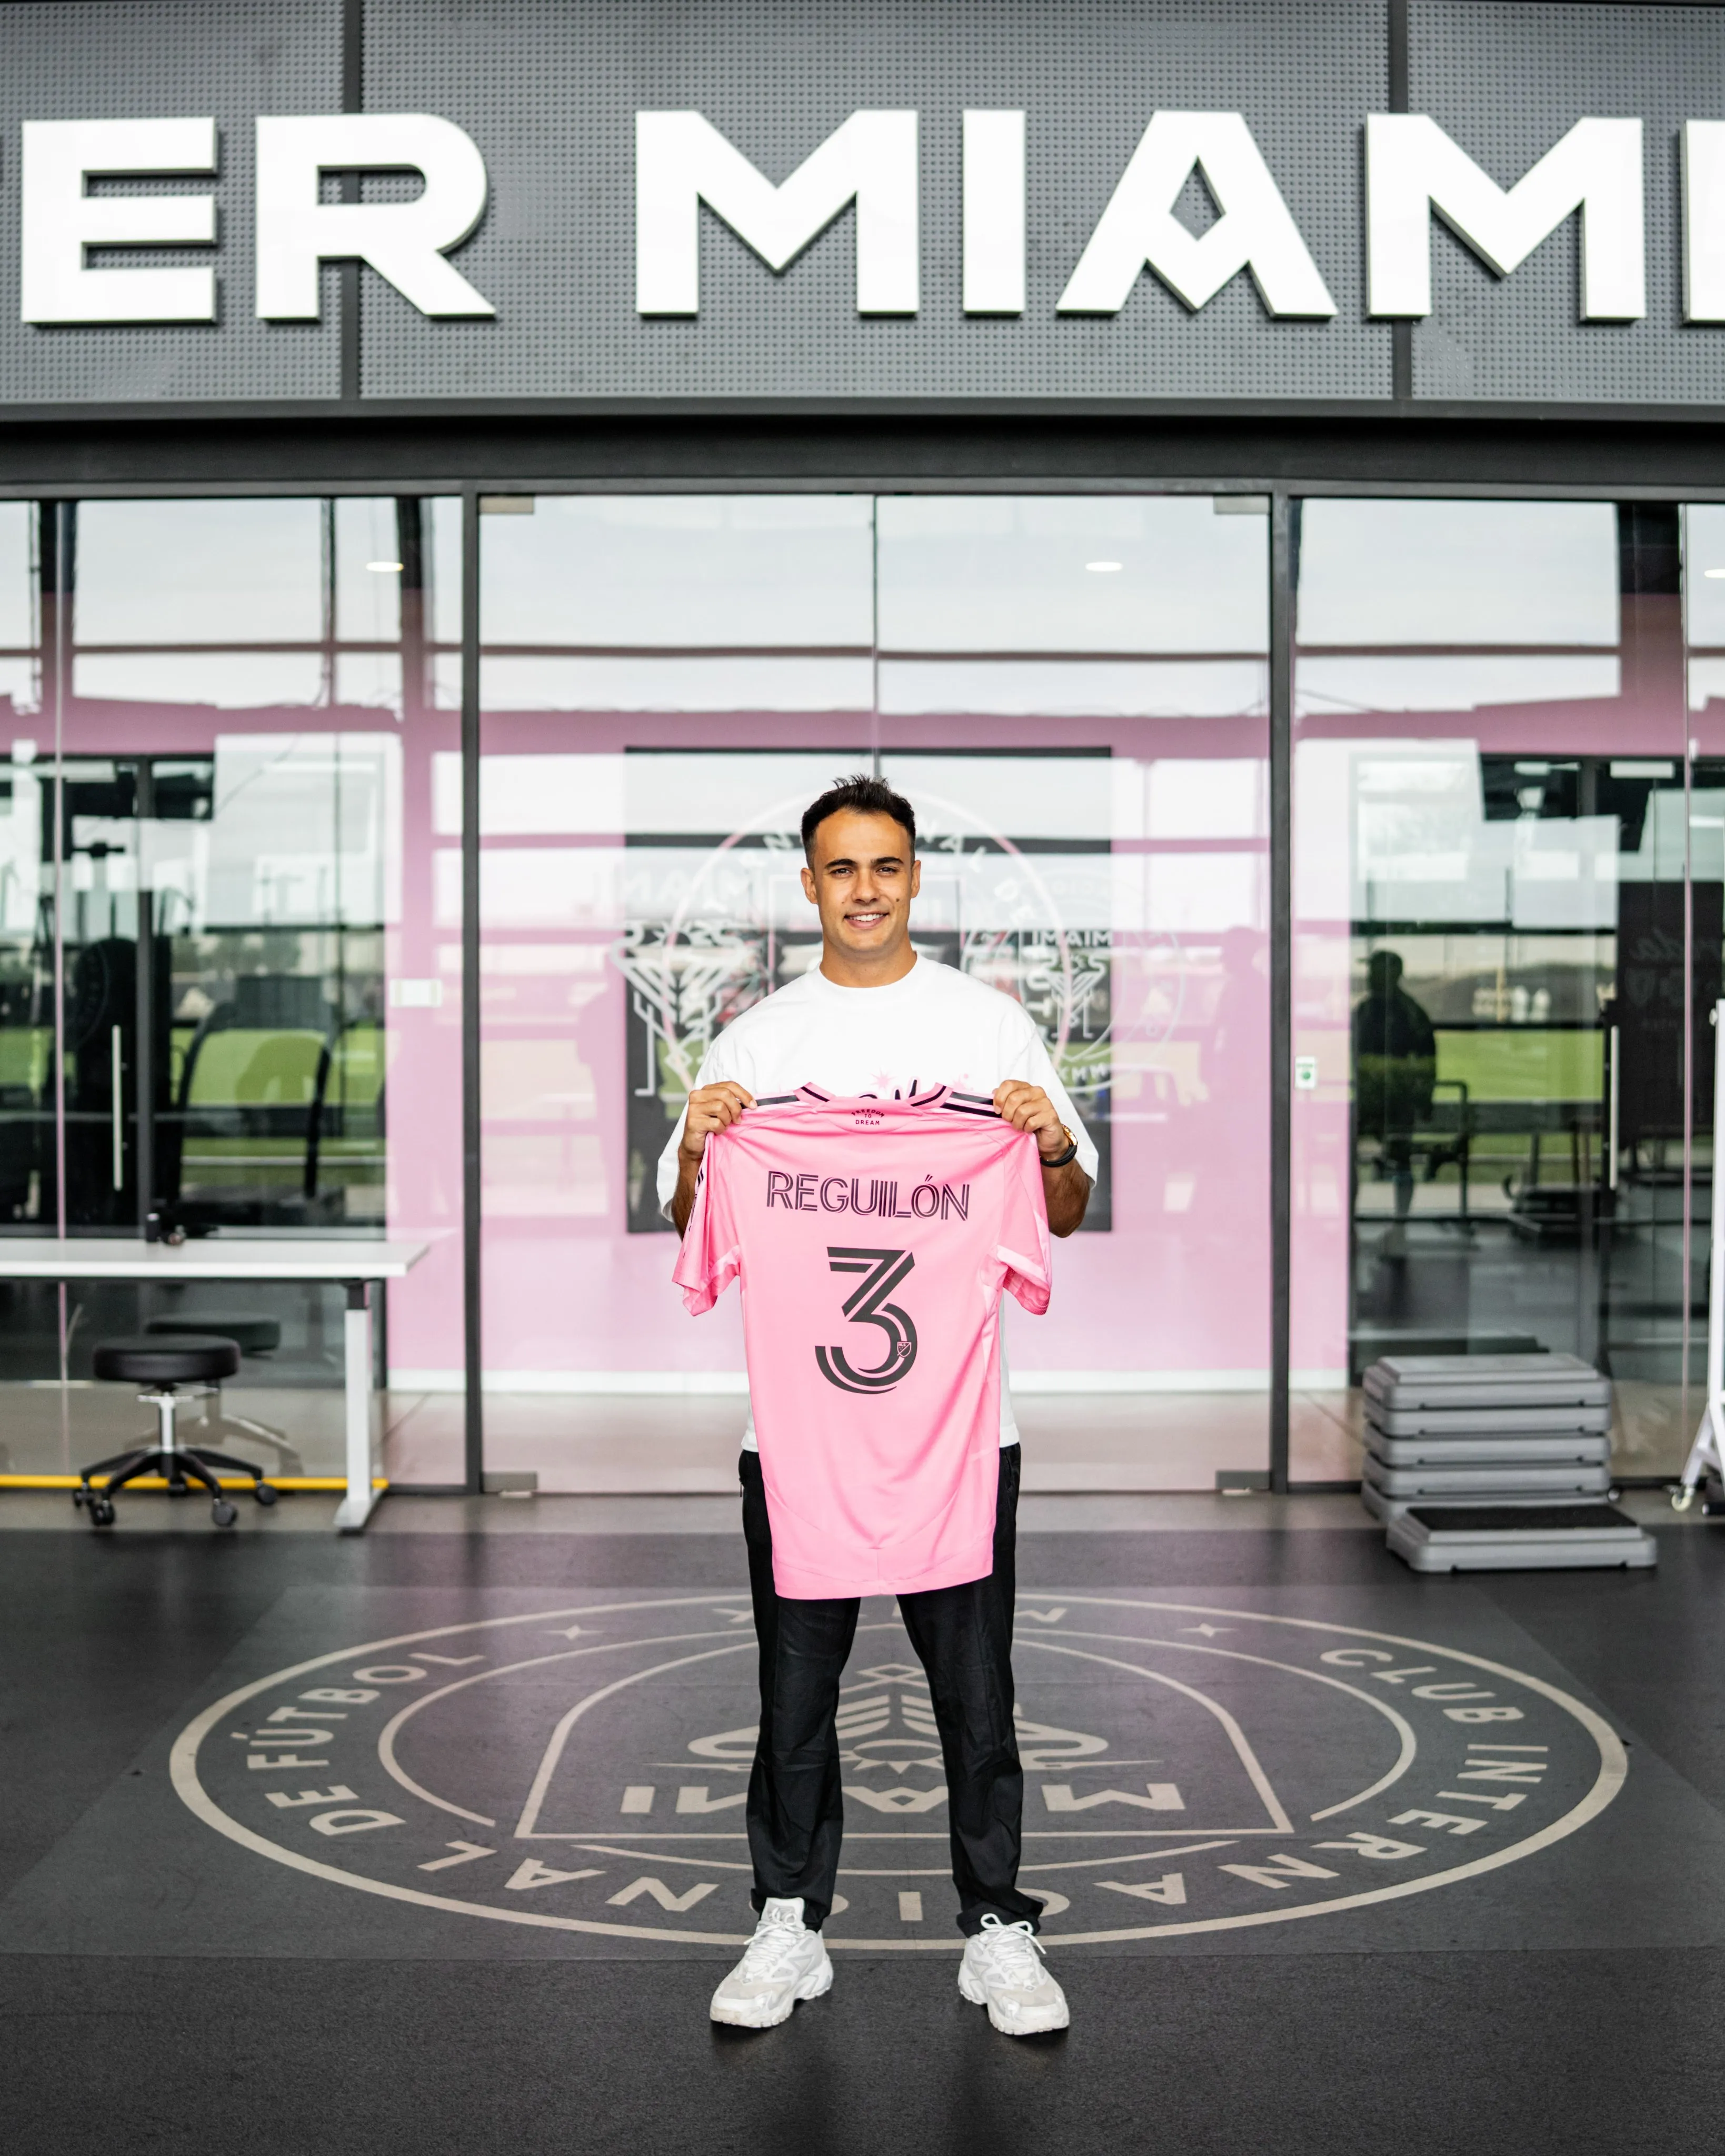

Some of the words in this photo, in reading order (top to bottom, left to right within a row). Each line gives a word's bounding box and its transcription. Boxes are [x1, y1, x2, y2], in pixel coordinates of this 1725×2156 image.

[21, 112, 497, 323] ER
[635, 109, 1725, 322] MIAMI
[852, 1109, 884, 1117] FREEDOM
[766, 1171, 970, 1221] REGUILÓN
[815, 1247, 918, 1395] 3
[231, 1652, 486, 1770] FÚTBOL
[1320, 1649, 1524, 1724] CLUB
[264, 1784, 406, 1835] DE
[416, 1744, 1549, 1922] INTERNAINAL
